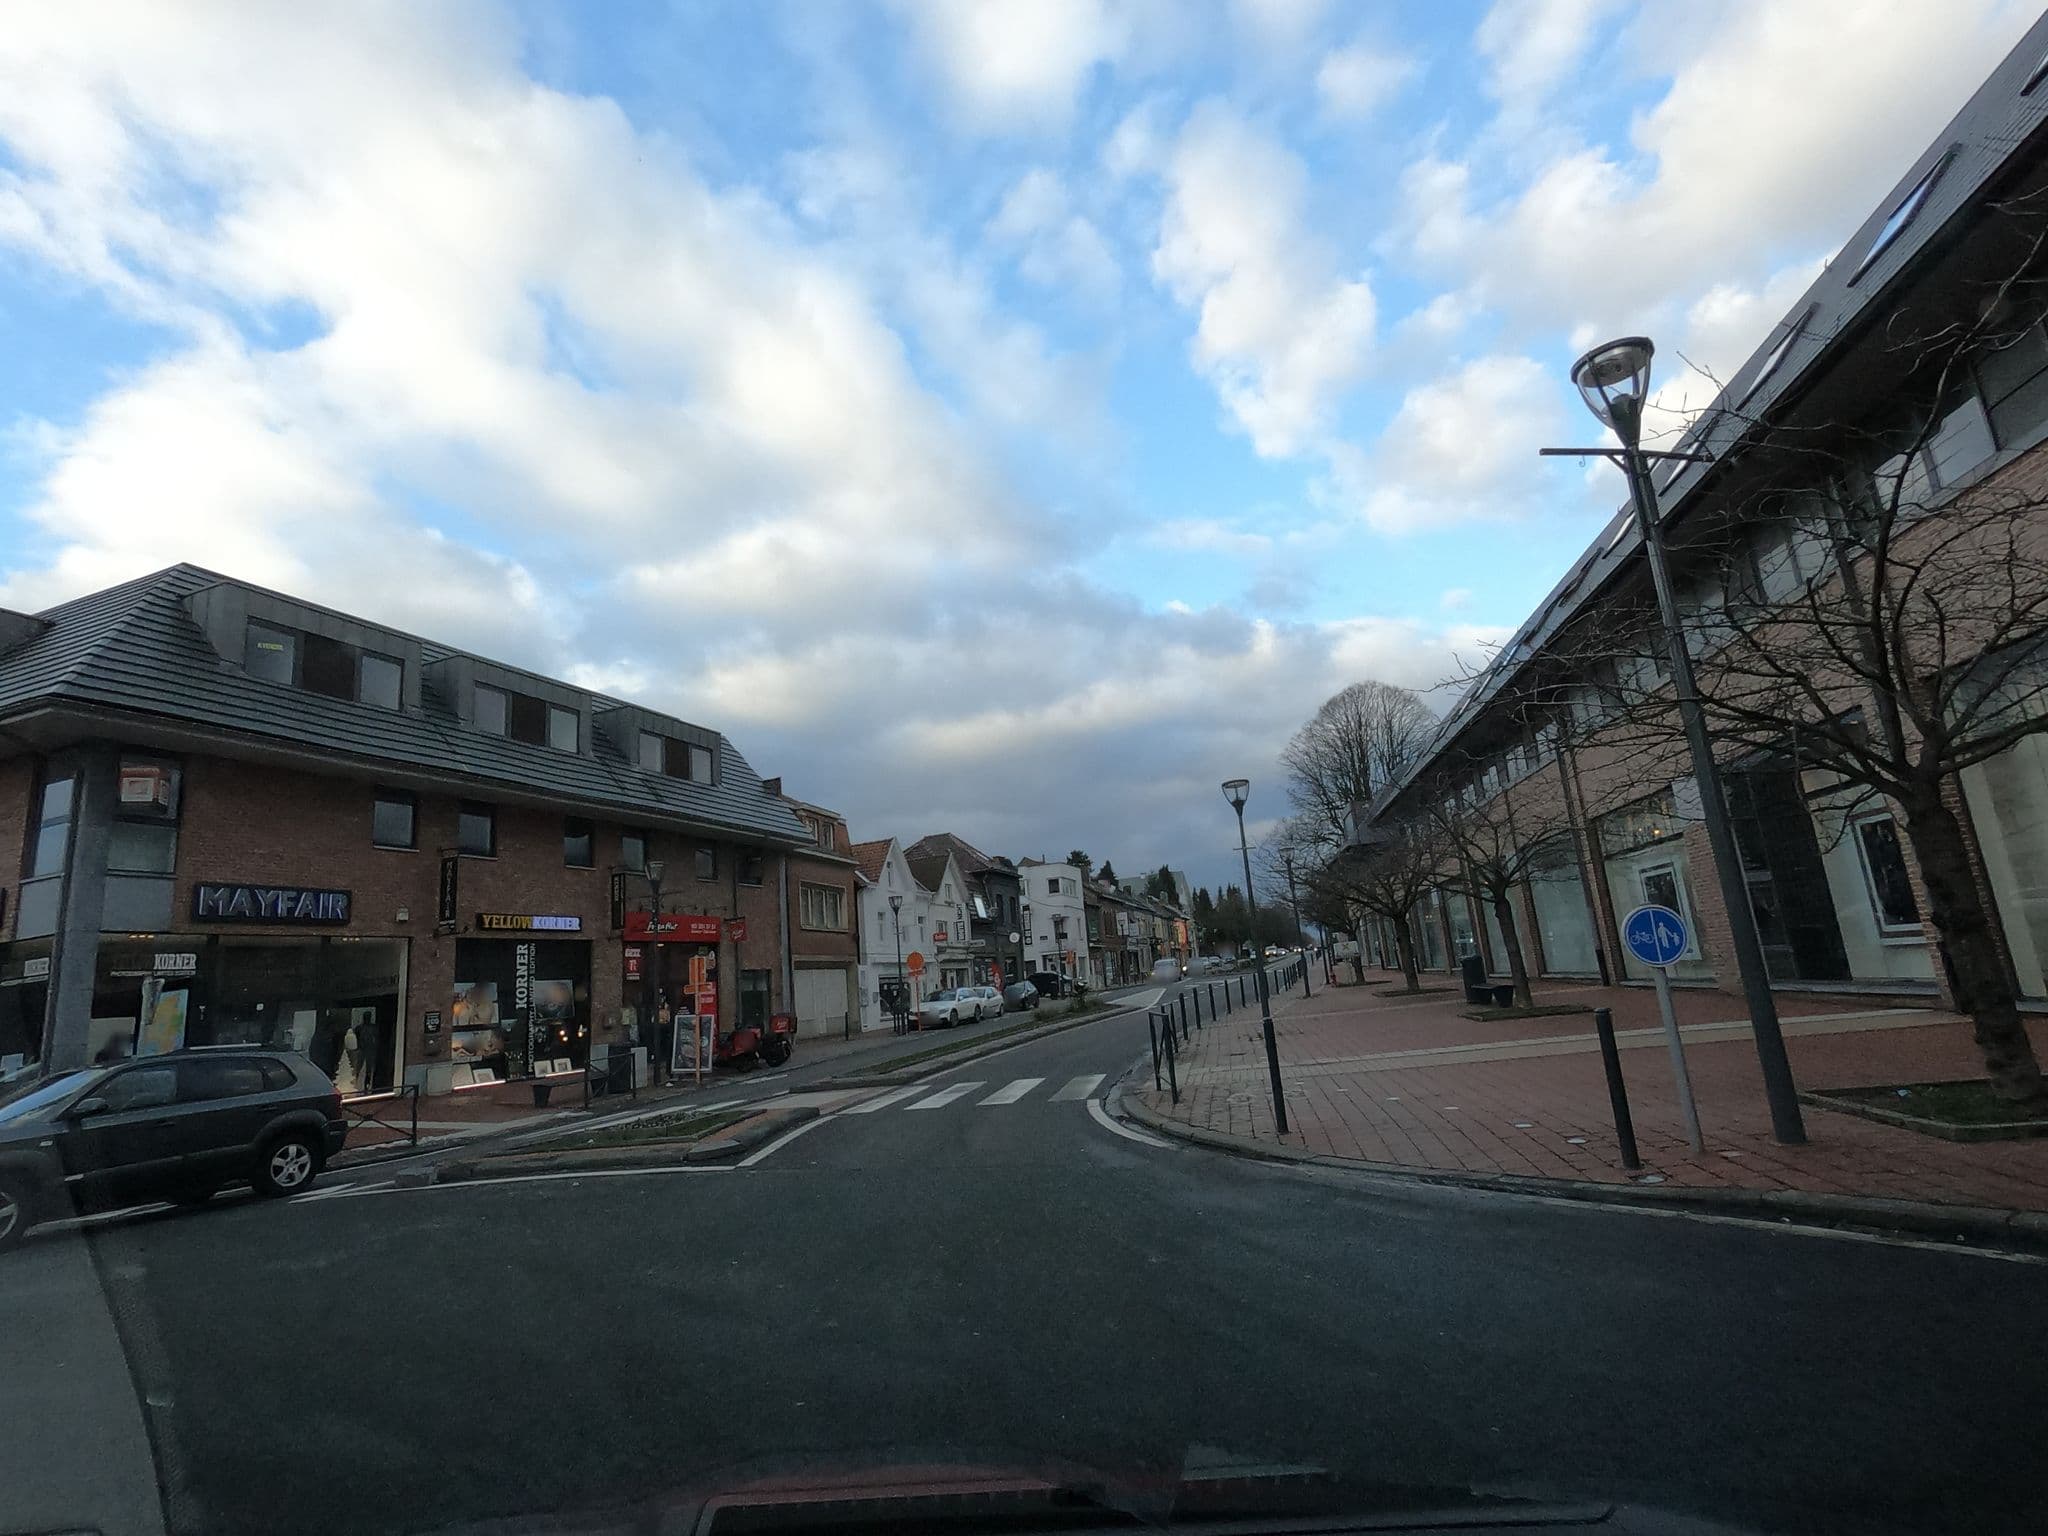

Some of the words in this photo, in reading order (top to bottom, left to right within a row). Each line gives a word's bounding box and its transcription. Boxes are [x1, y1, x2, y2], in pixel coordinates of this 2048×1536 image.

[198, 886, 348, 919] MAYFAIR
[153, 953, 196, 970] KORNER
[528, 943, 536, 974] EDITION
[515, 944, 528, 1010] KORNER
